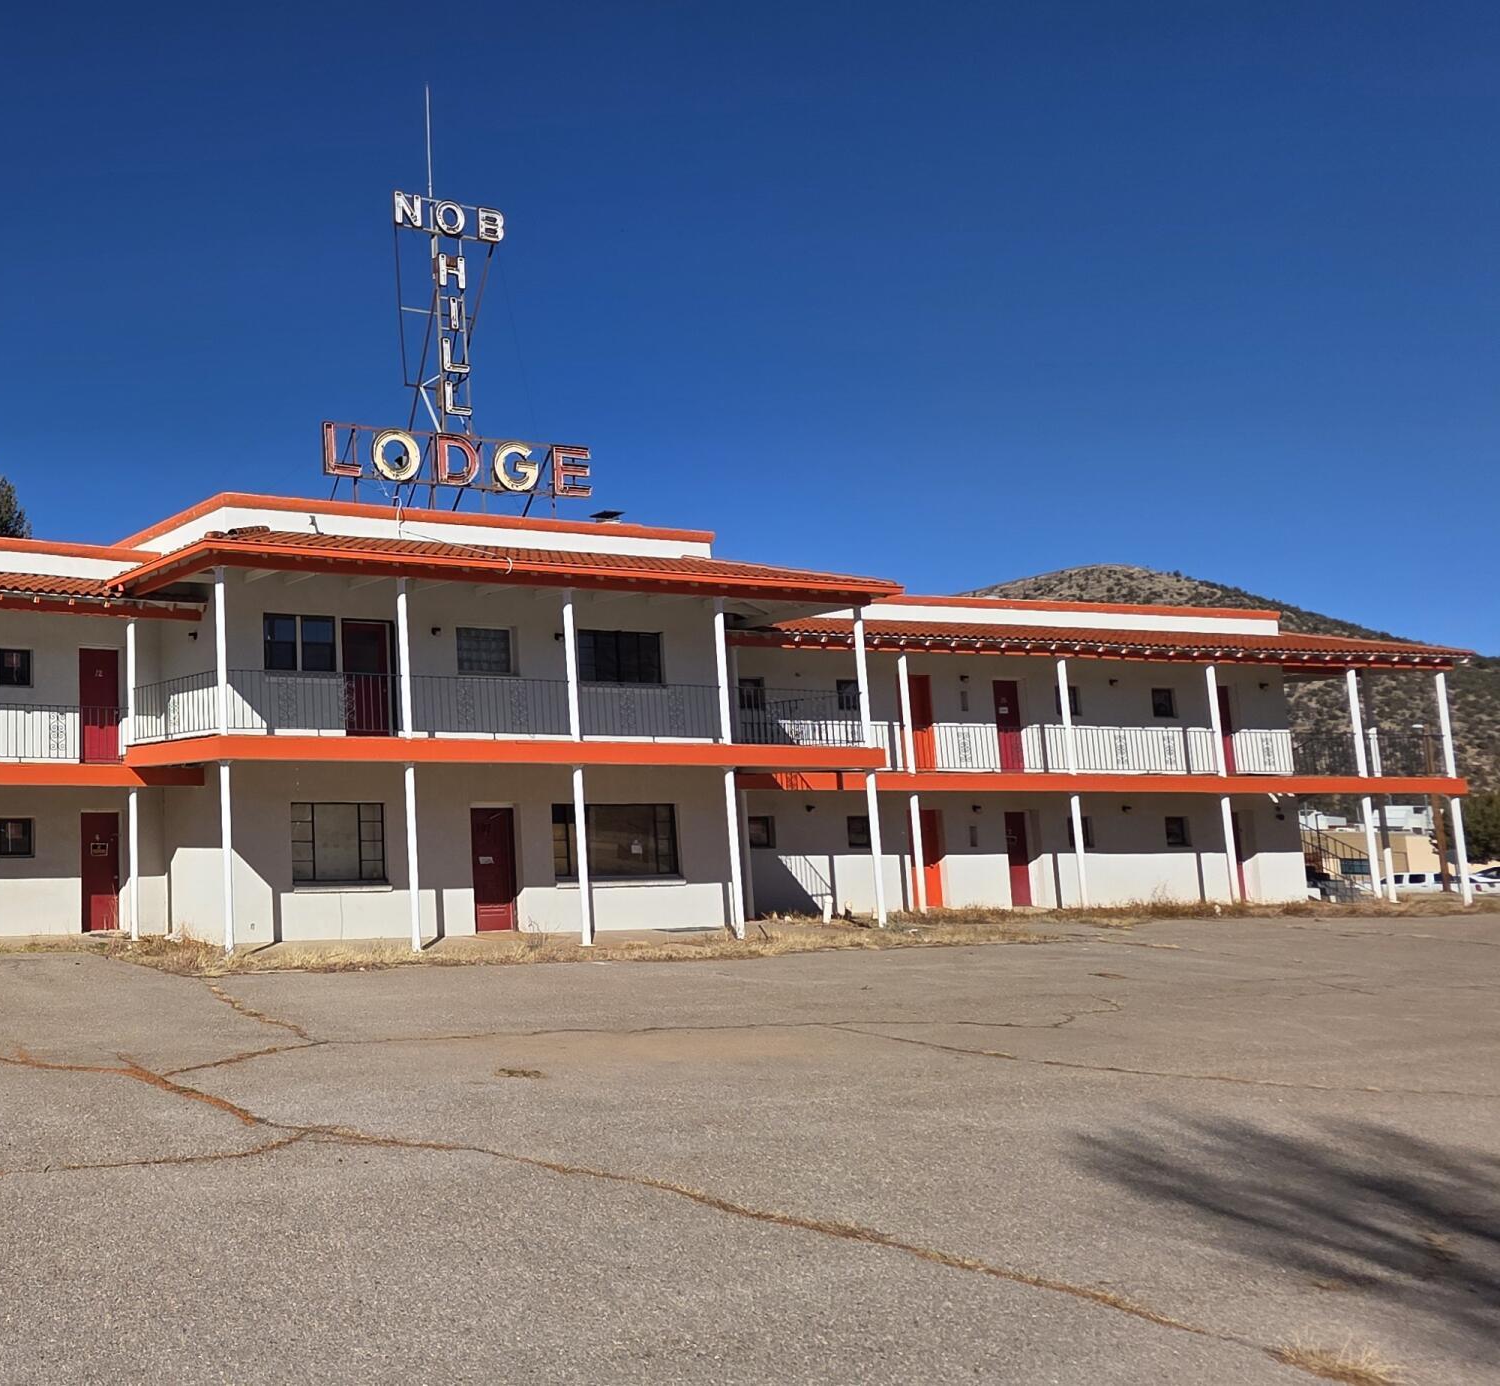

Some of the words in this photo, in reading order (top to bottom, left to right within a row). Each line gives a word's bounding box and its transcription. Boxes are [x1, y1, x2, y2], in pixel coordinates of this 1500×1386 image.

[393, 190, 505, 243] NOB
[437, 253, 472, 416] HILL
[322, 421, 593, 498] LODGE
